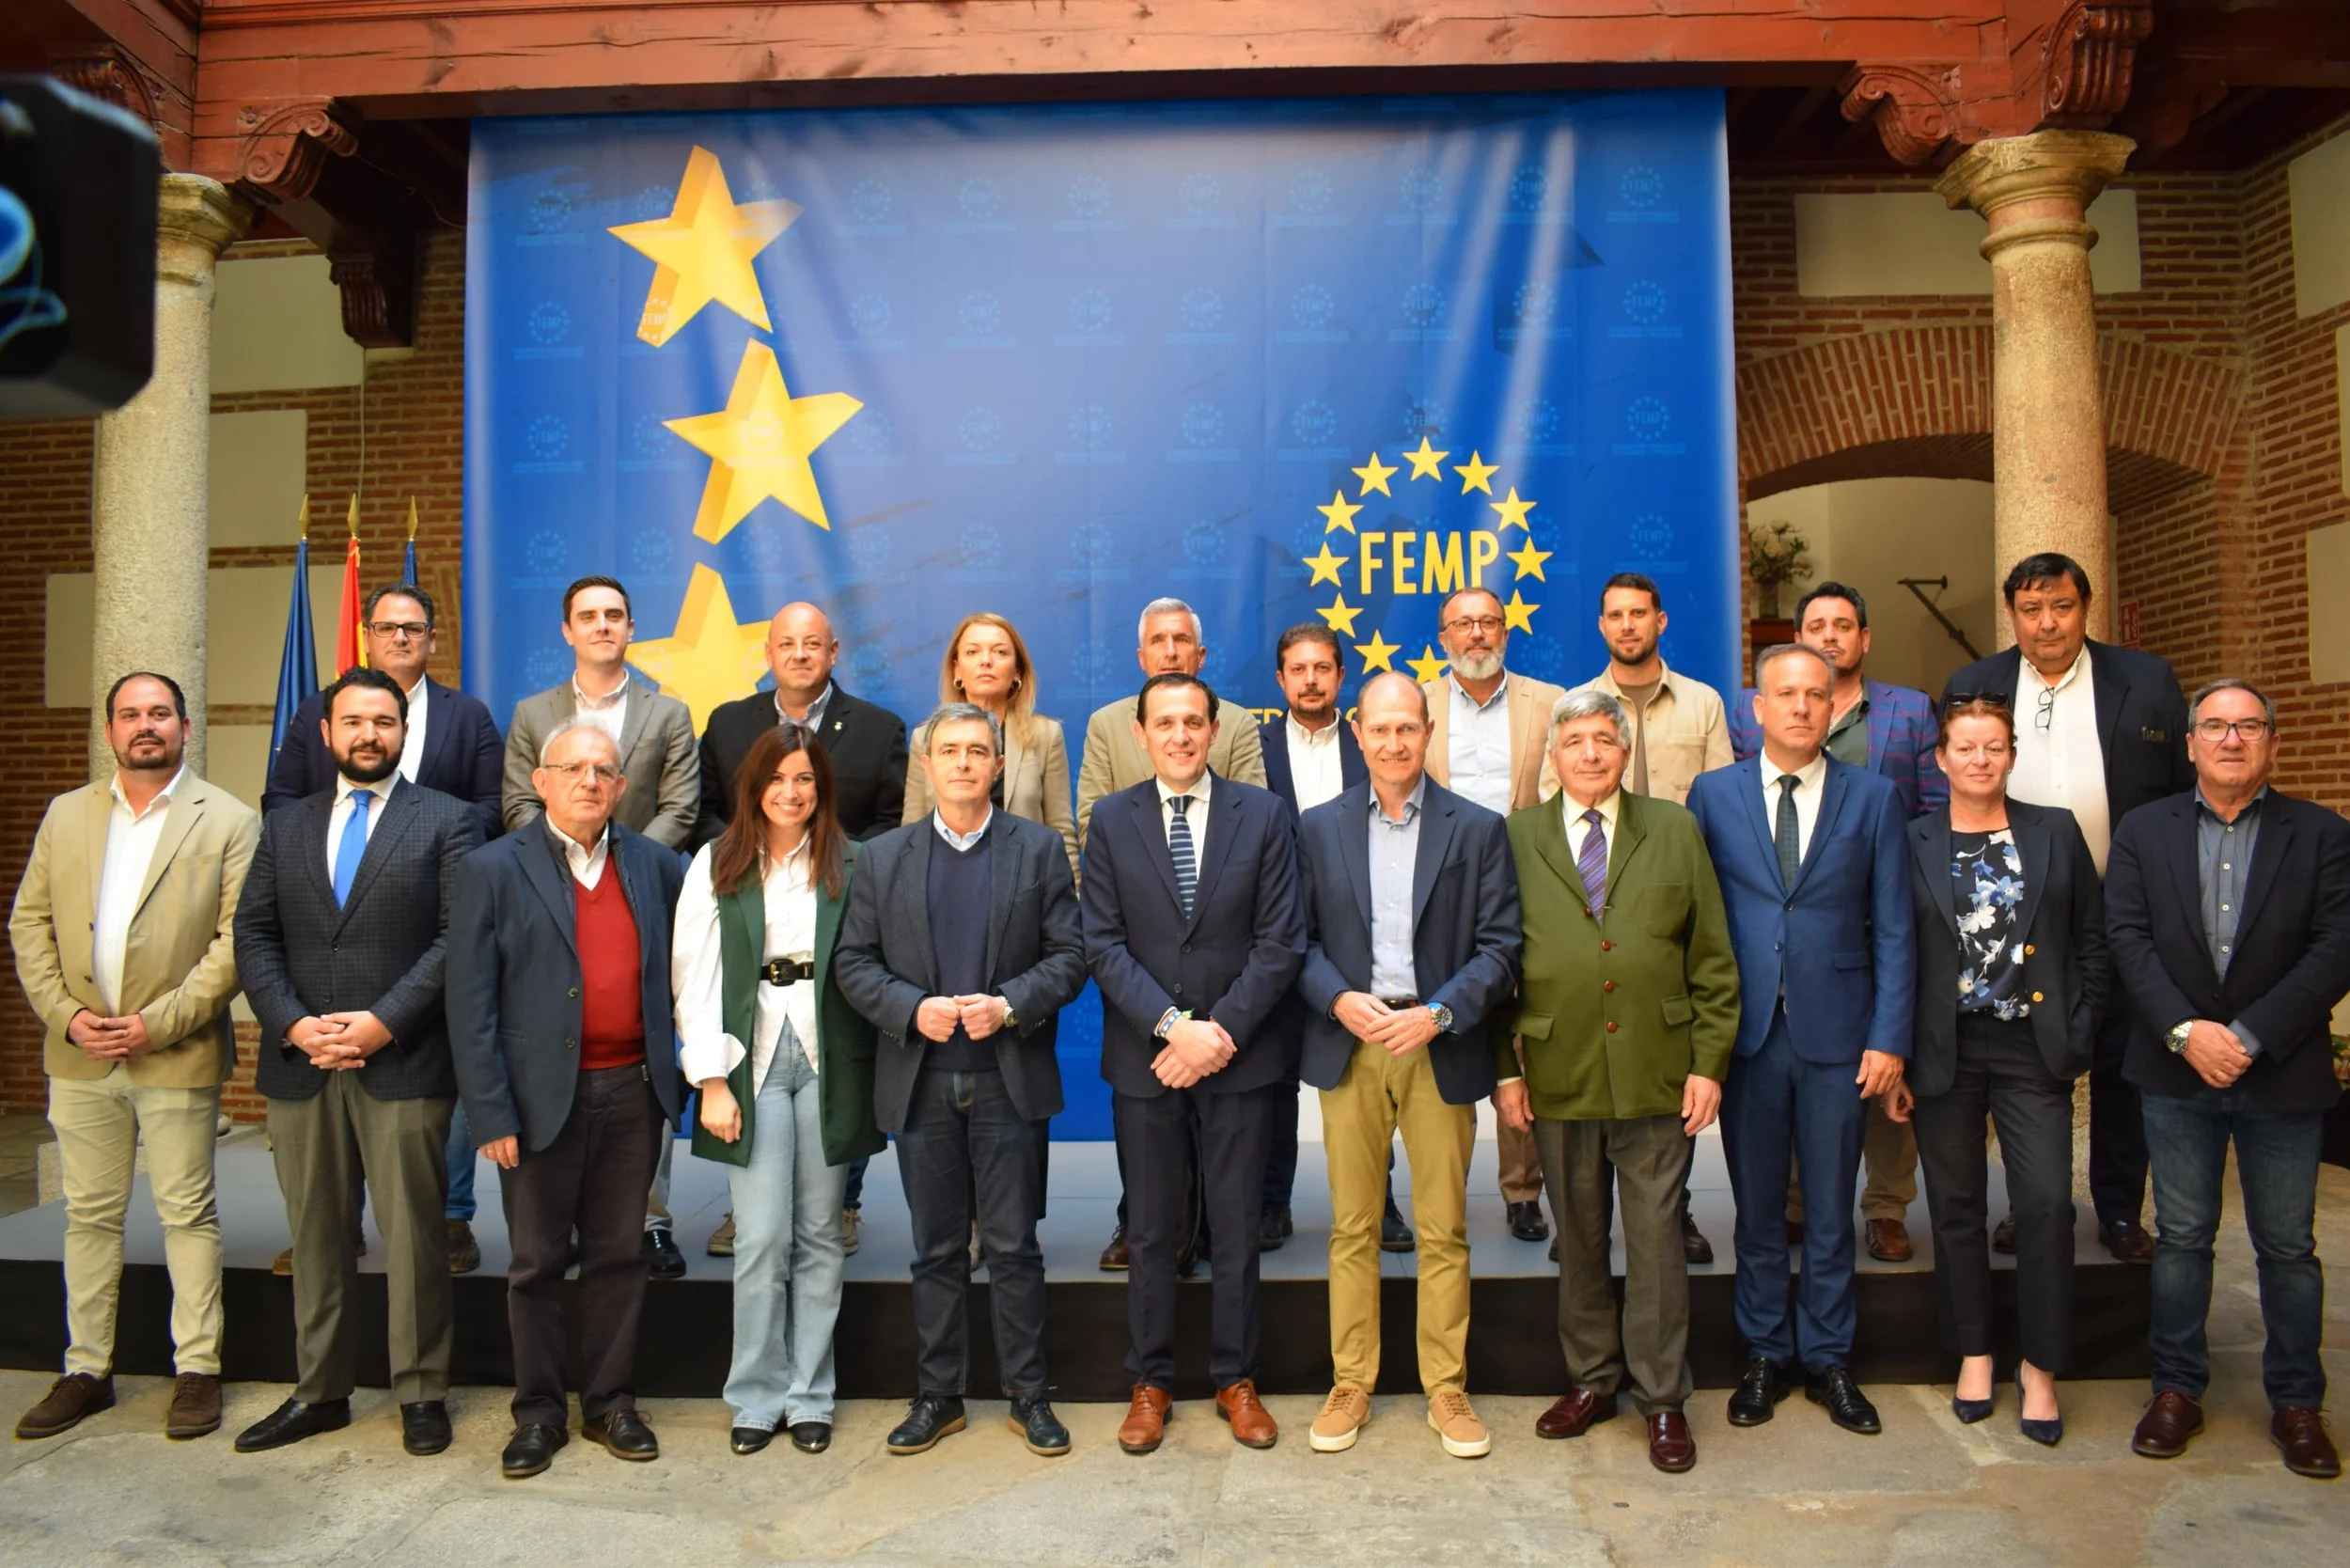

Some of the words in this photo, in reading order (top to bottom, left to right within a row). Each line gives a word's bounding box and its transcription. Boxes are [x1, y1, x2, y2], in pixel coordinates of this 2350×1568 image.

[1628, 180, 1653, 194] FEMP
[1299, 300, 1324, 313] FEMP
[1632, 295, 1657, 308] FEMP
[537, 316, 561, 329] FEMP
[1189, 418, 1214, 431] FEMP
[1301, 416, 1326, 430] FEMP
[1635, 412, 1660, 425] FEMP
[535, 431, 559, 444] FEMP
[1638, 529, 1664, 542] FEMP
[1191, 536, 1216, 549] FEMP
[1360, 531, 1499, 595] FEMP
[1529, 649, 1555, 662] FEMP
